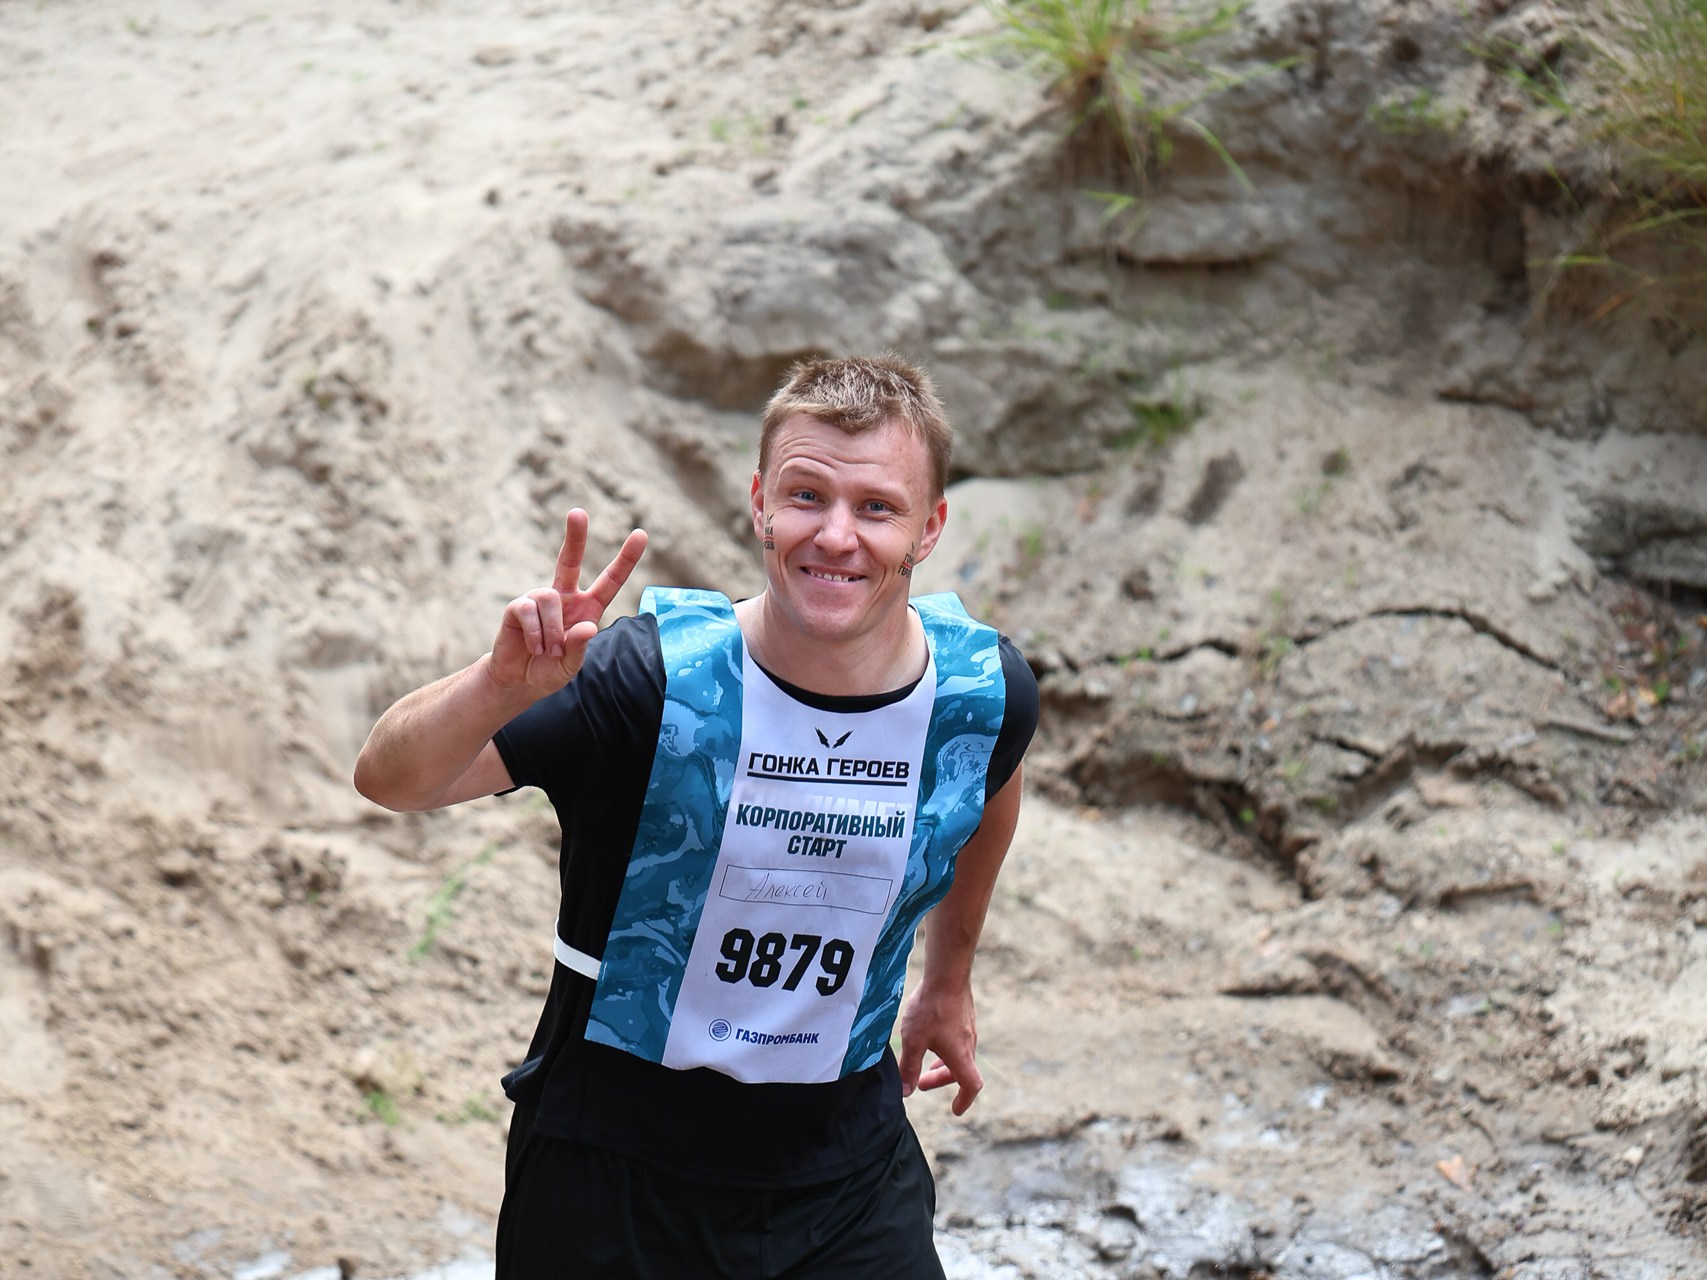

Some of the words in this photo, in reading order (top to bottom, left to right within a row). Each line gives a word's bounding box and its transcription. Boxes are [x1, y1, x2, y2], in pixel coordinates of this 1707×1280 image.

[748, 752, 820, 776] ГОНКА
[826, 758, 910, 779] ГЕРОЕВ
[735, 804, 906, 839] КОРПОРАТИВНЫЙ
[786, 835, 848, 859] СТАРТ
[744, 873, 829, 900] Алексей
[715, 928, 855, 996] 9879
[735, 1028, 820, 1045] ГАЗПРОМБАНК
